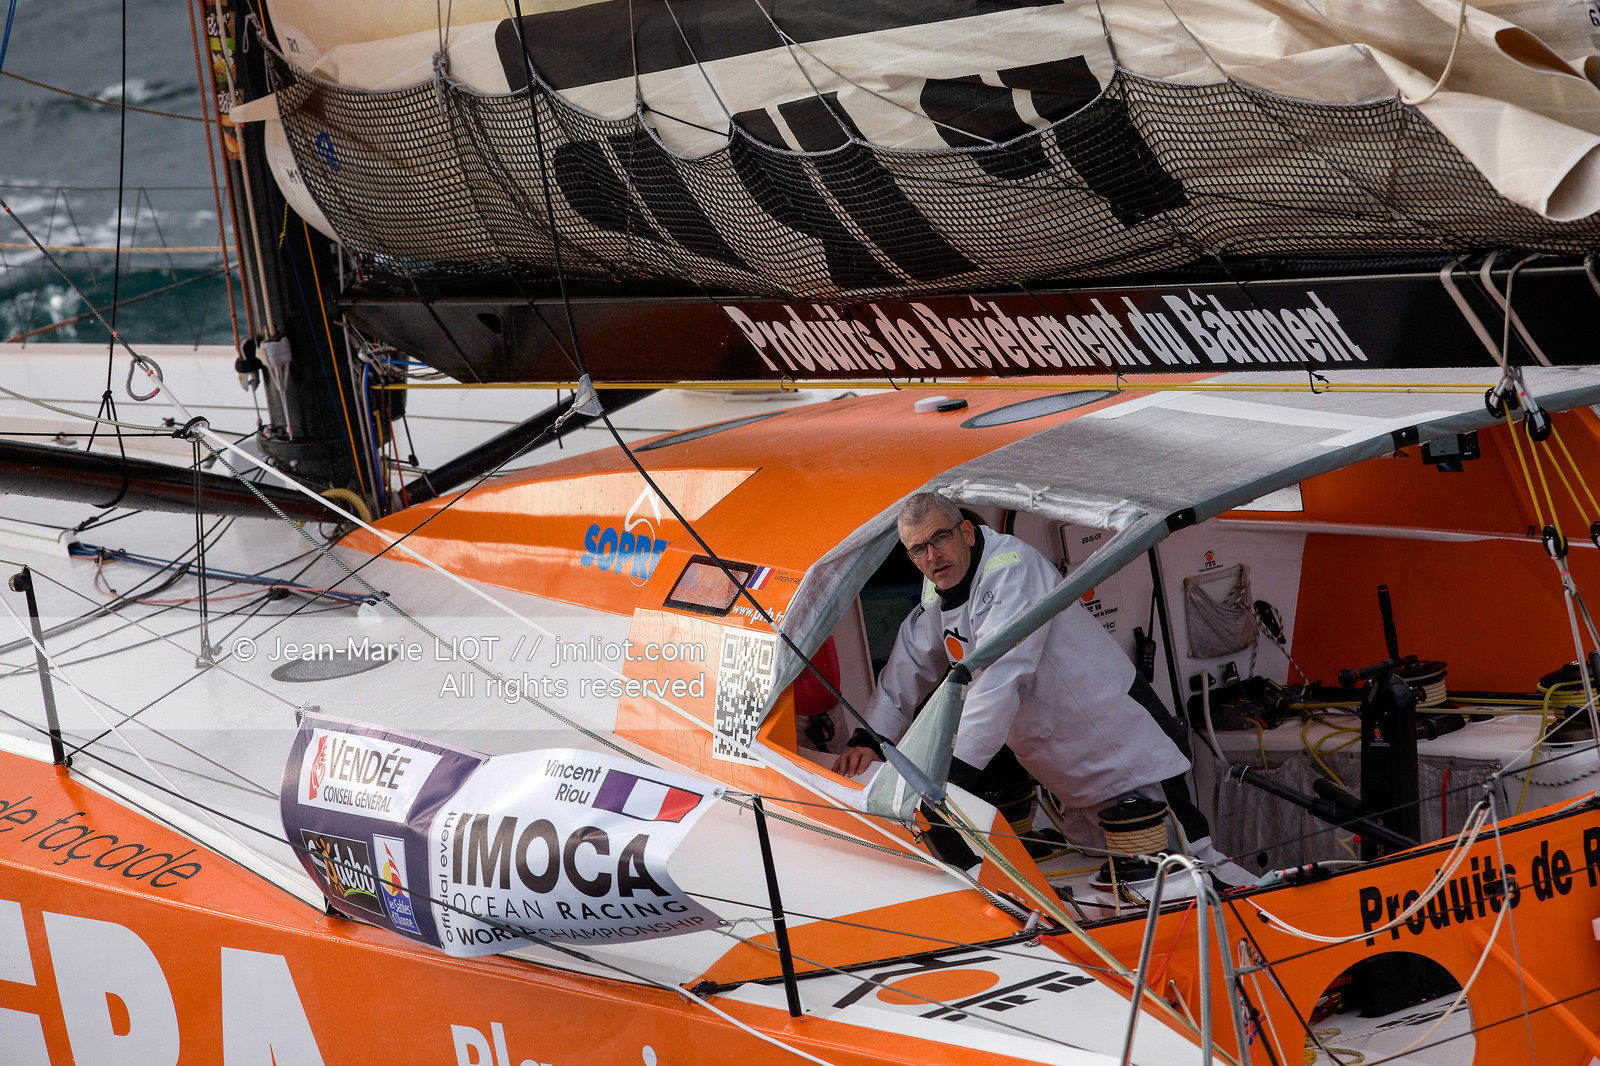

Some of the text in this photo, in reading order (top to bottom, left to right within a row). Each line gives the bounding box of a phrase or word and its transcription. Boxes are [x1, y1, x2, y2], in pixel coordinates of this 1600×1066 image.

[722, 288, 1369, 372] Produits de Revêtement du Bâtiment
[1081, 533, 1102, 544] B&G
[329, 738, 412, 790] VENDÉE
[544, 759, 602, 784] Vincent
[323, 785, 392, 813] CONSEIL GÉNÉRAL
[555, 783, 591, 805] Riou
[21, 811, 202, 888] façade
[452, 812, 672, 898] IMOCA
[439, 810, 457, 943] official event
[1358, 855, 1522, 947] Produits
[1531, 840, 1573, 902] de
[453, 892, 689, 920] OCEAN RACING
[456, 915, 705, 946] WORLD CHAMPIONSHIP
